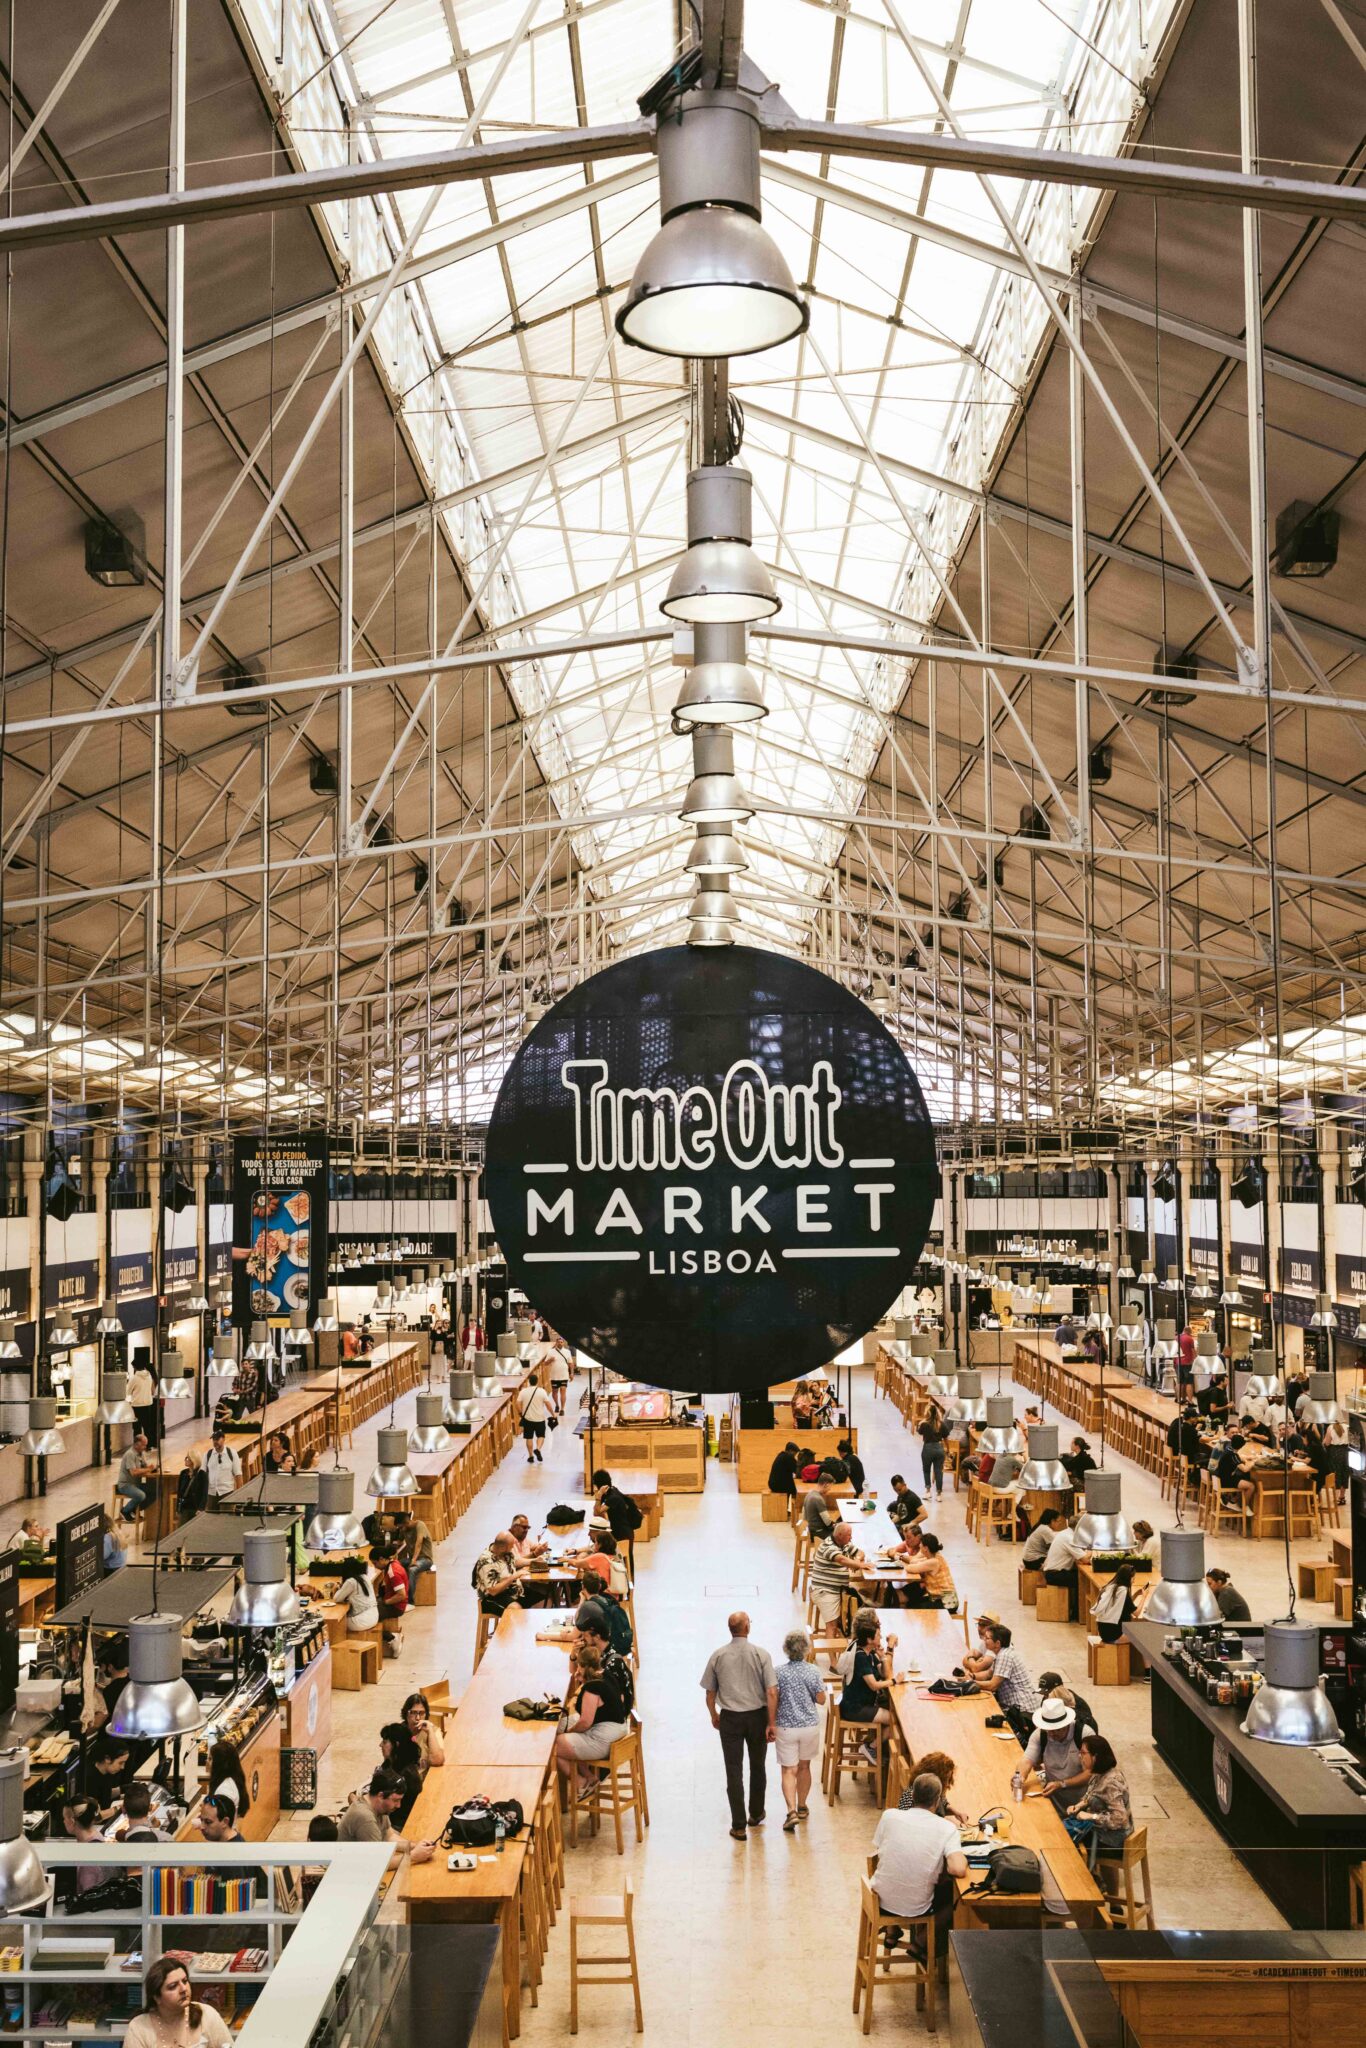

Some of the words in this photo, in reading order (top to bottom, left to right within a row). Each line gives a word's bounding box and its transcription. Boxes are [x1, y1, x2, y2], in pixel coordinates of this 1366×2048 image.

[562, 1059, 717, 1170] Time
[721, 1059, 844, 1169] Out
[241, 1159, 263, 1169] TODOS
[274, 1159, 323, 1169] RESTAURANTES
[247, 1168, 257, 1177] DO
[275, 1168, 288, 1177] OUT
[290, 1168, 317, 1177] MARKET
[271, 1176, 285, 1185] SUA
[286, 1176, 304, 1185] CASA
[526, 1183, 896, 1237] MARKET
[338, 1242, 376, 1256] SUSAA
[649, 1249, 778, 1275] LISBOA
